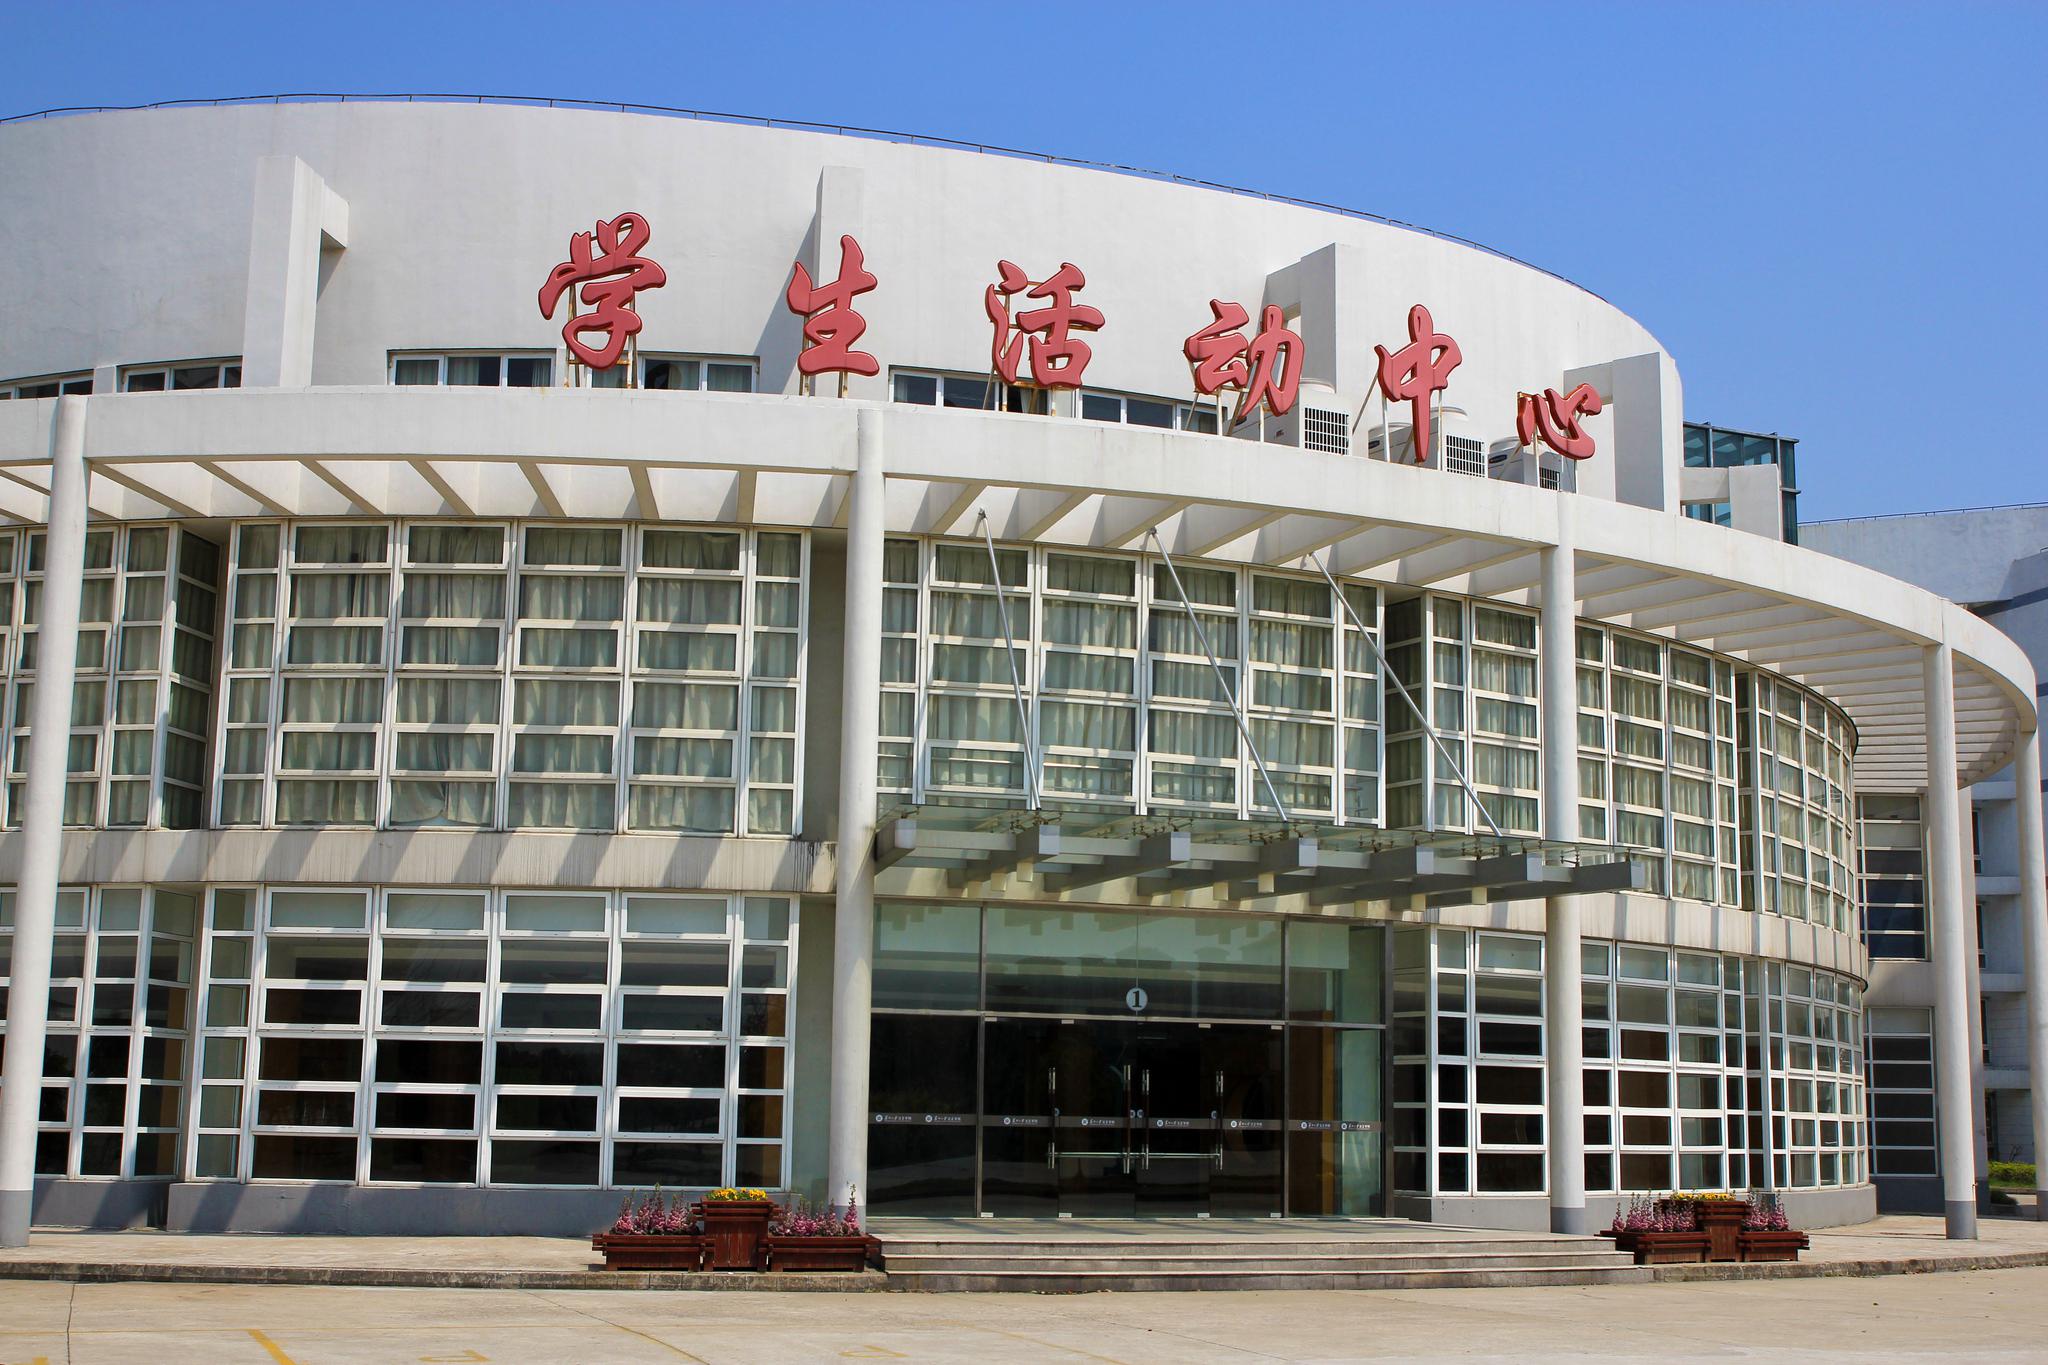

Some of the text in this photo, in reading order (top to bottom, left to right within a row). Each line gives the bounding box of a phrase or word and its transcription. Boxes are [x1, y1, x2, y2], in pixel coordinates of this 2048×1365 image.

[538, 211, 1602, 463] 学生活动中心
[1132, 990, 1142, 1008] 1
